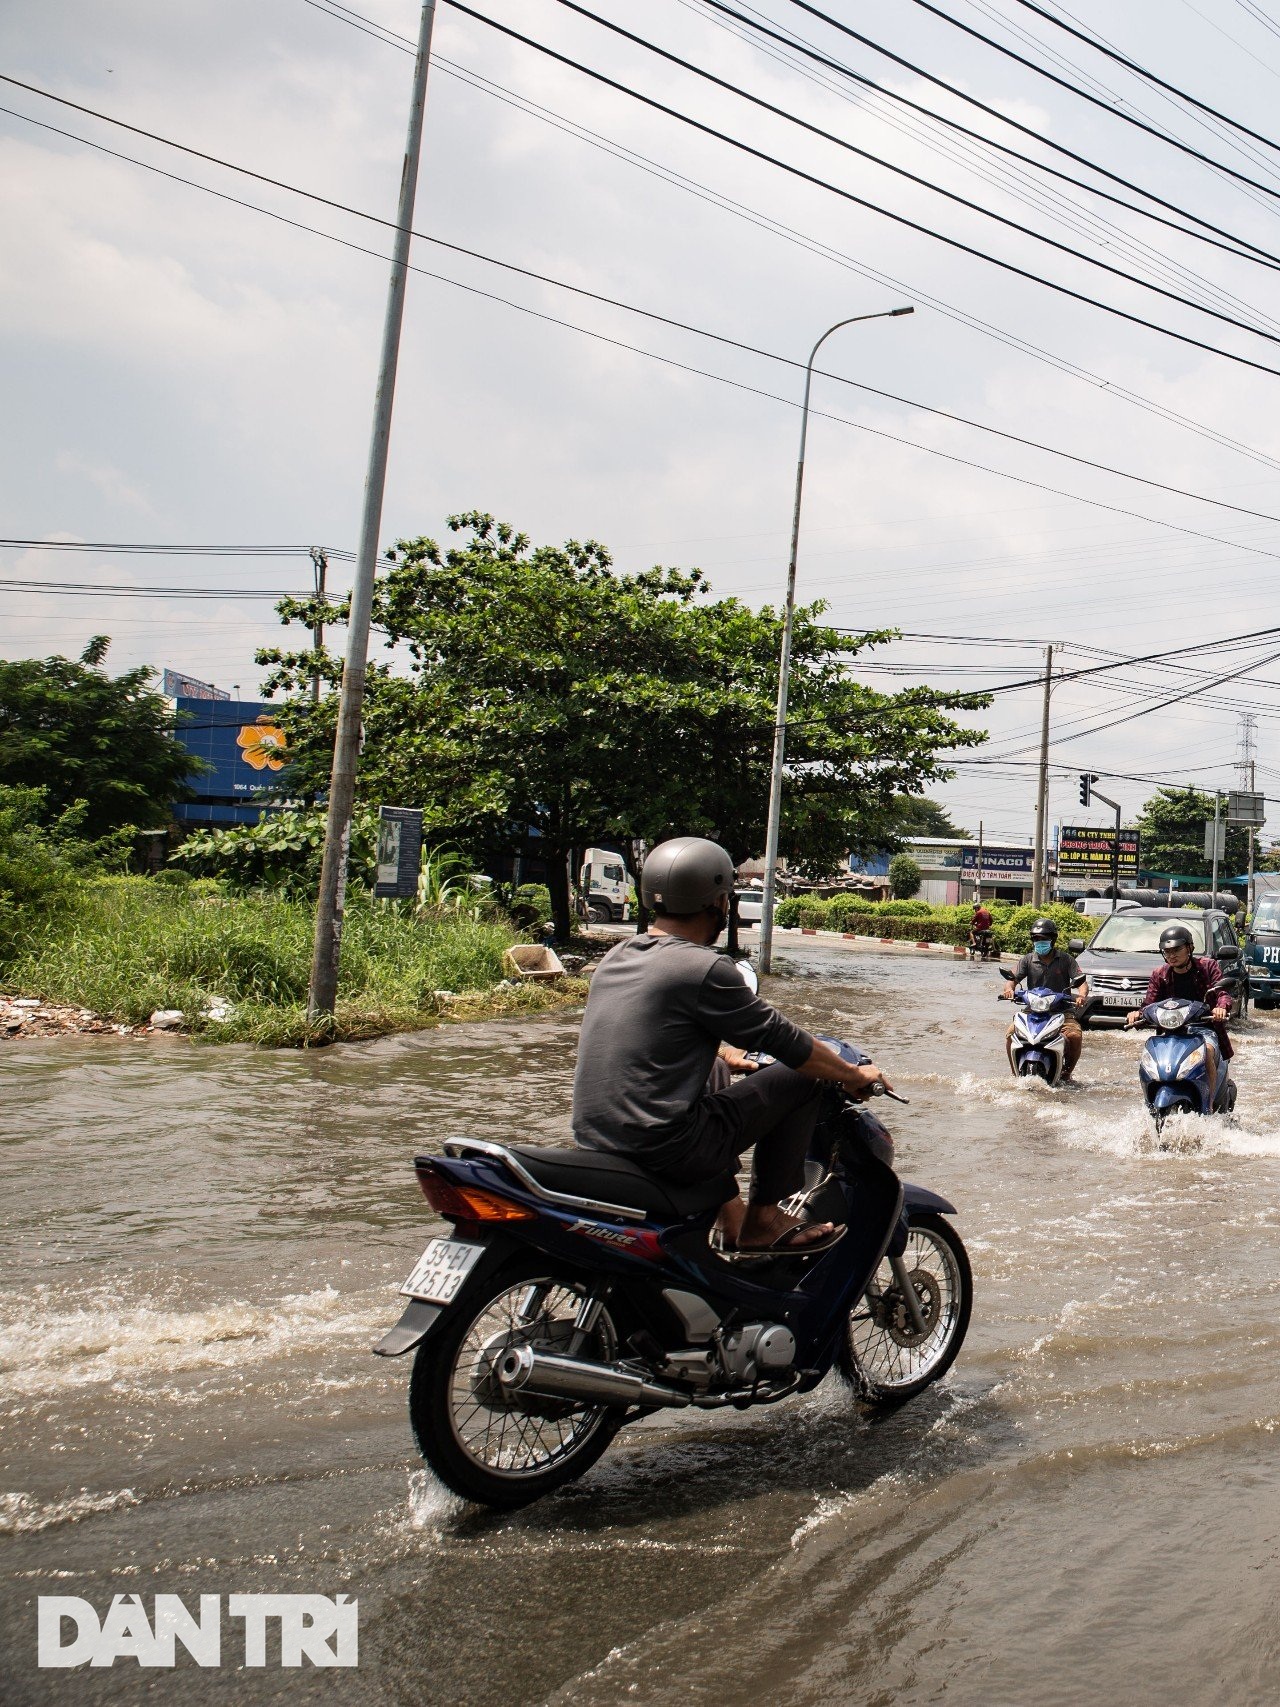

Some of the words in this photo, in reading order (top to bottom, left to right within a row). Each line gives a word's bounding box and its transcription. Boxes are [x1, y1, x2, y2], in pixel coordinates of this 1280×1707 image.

[975, 857, 1024, 866] PINACO
[426, 1242, 474, 1272] 59-E1
[405, 1267, 462, 1299] 425.13
